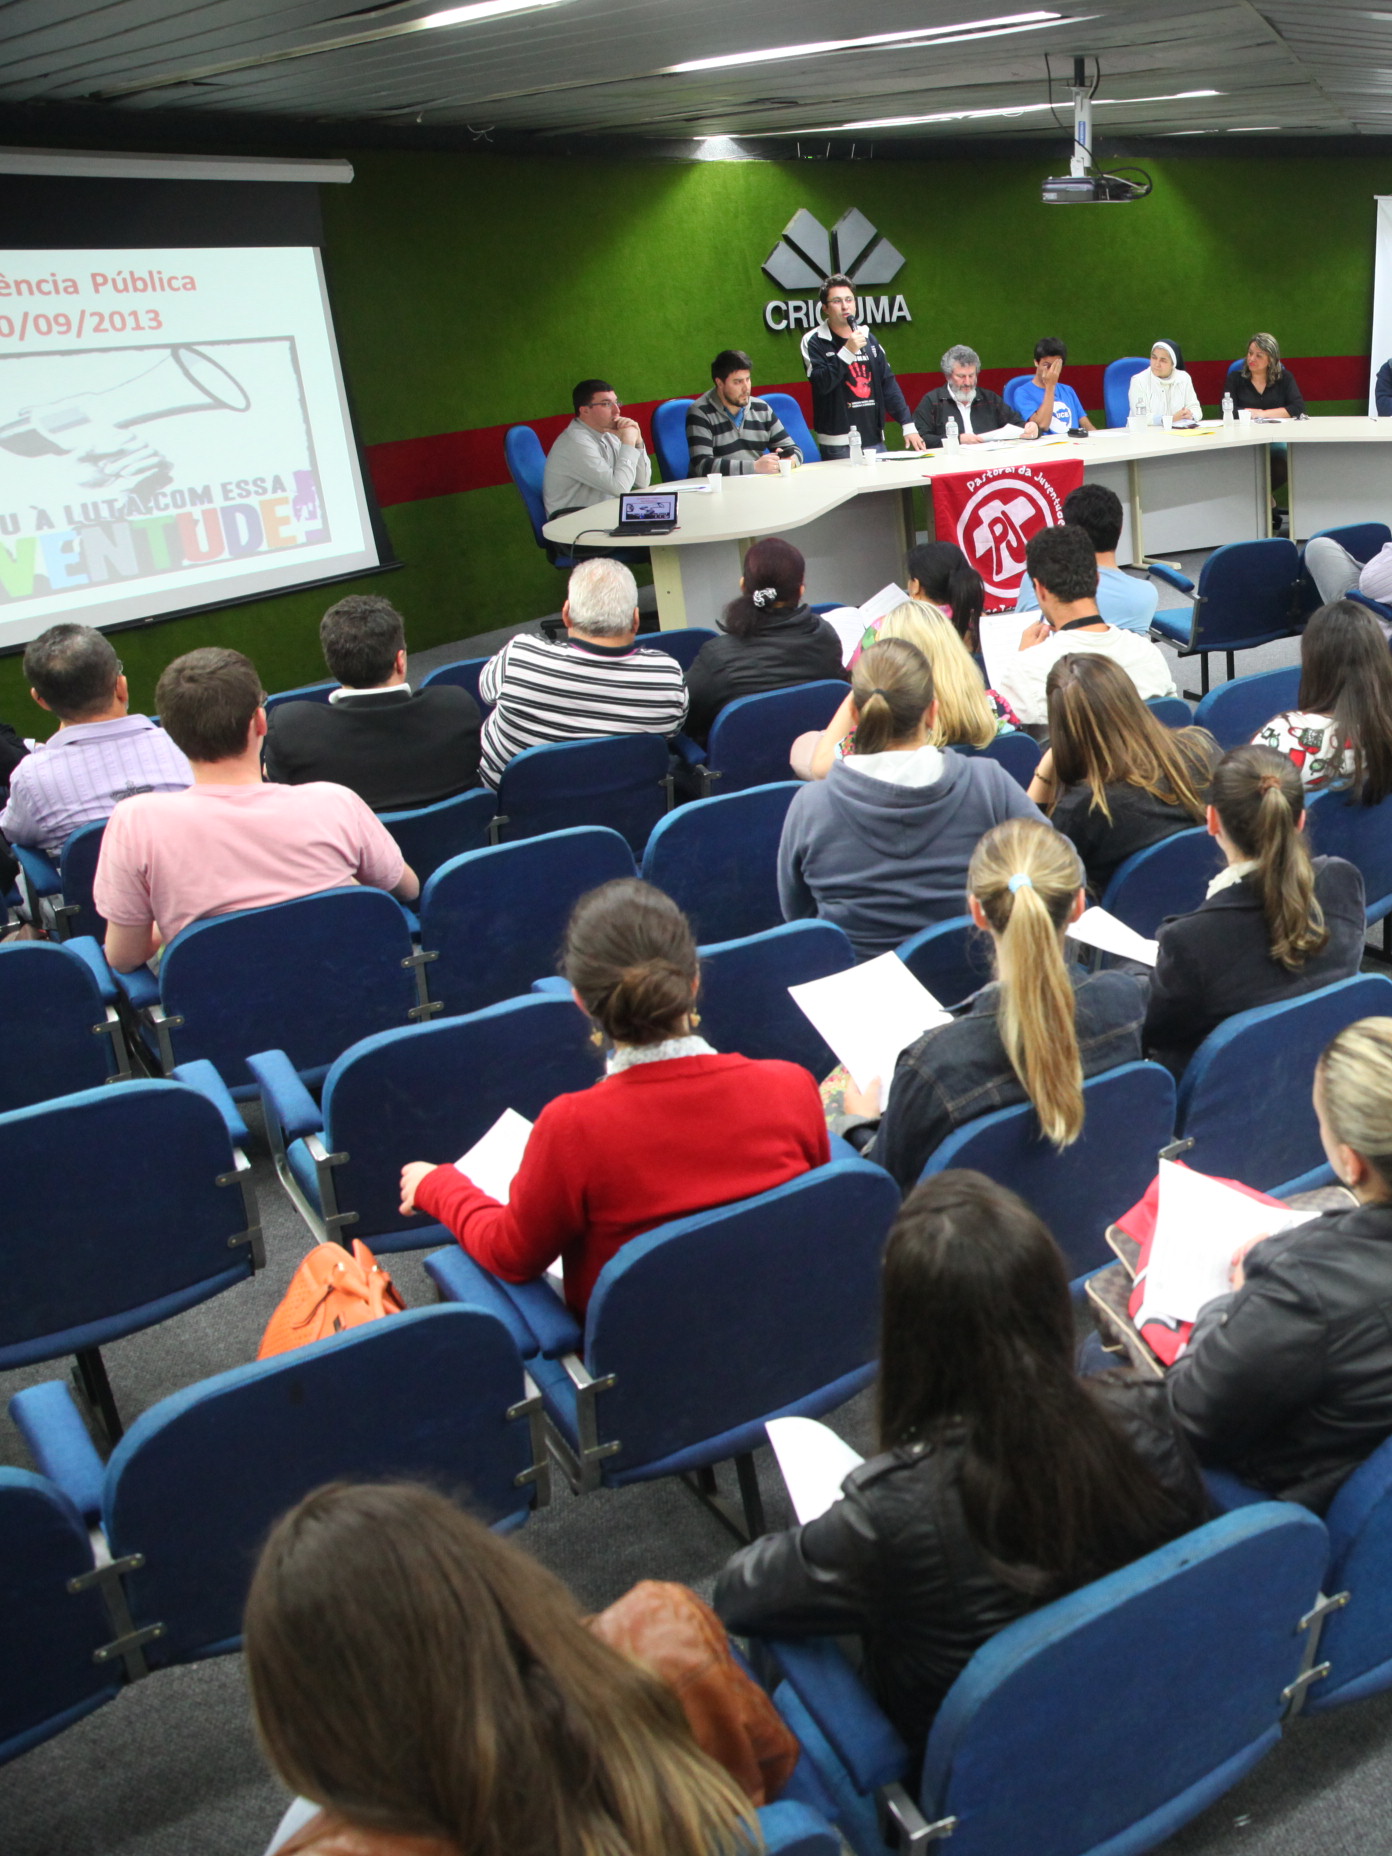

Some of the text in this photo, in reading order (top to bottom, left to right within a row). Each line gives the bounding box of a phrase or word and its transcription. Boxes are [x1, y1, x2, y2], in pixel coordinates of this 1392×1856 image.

[90, 270, 197, 295] Pública
[765, 294, 912, 331] CRIMA
[966, 466, 1016, 492] Pastoral
[1018, 465, 1032, 477] da
[29, 505, 56, 531] À
[63, 493, 150, 526] LUTA
[153, 484, 214, 512] COM
[220, 474, 288, 502] ESSA
